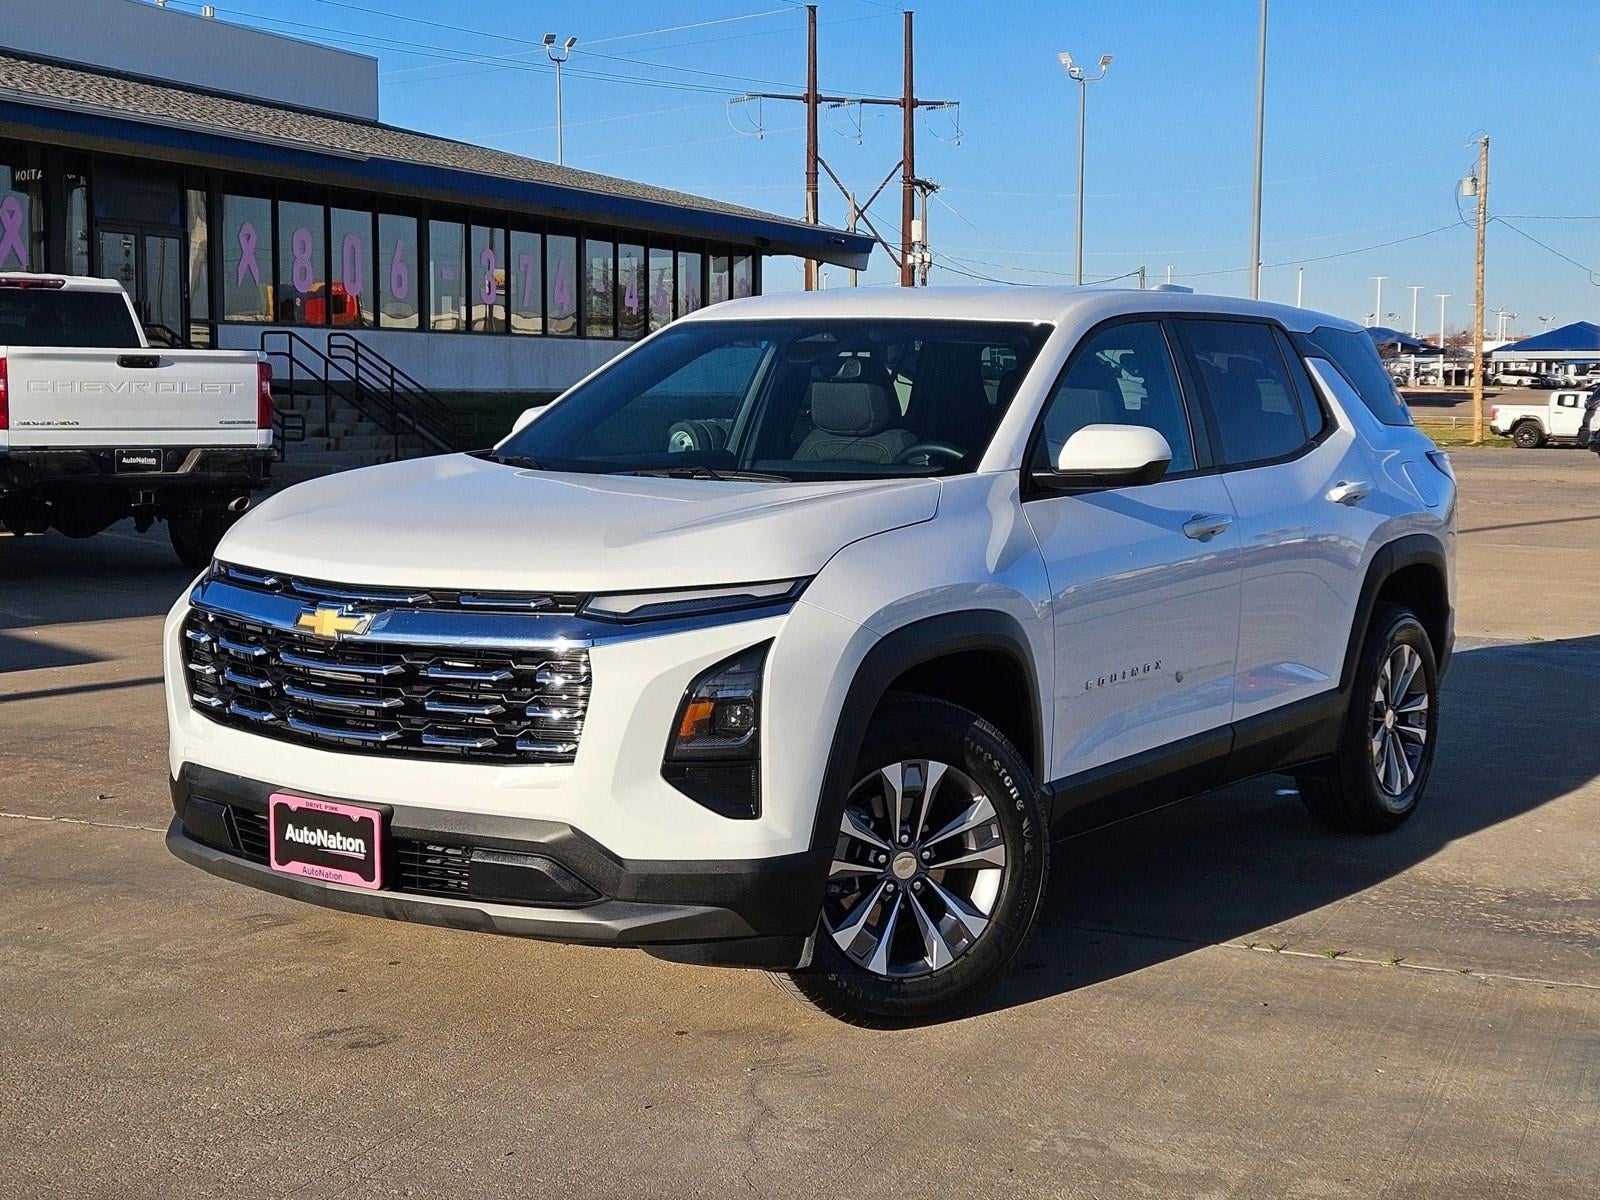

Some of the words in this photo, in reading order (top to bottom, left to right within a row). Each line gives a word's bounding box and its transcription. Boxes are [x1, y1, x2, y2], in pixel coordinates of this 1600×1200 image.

[26, 380, 245, 394] CHEVROLET
[122, 456, 156, 464] AutoNation
[1085, 660, 1162, 690] EQUINOX
[305, 801, 323, 810] DRIVE
[324, 804, 339, 812] PINK
[284, 823, 367, 853] AutoNation
[302, 865, 343, 881] AutoNation
